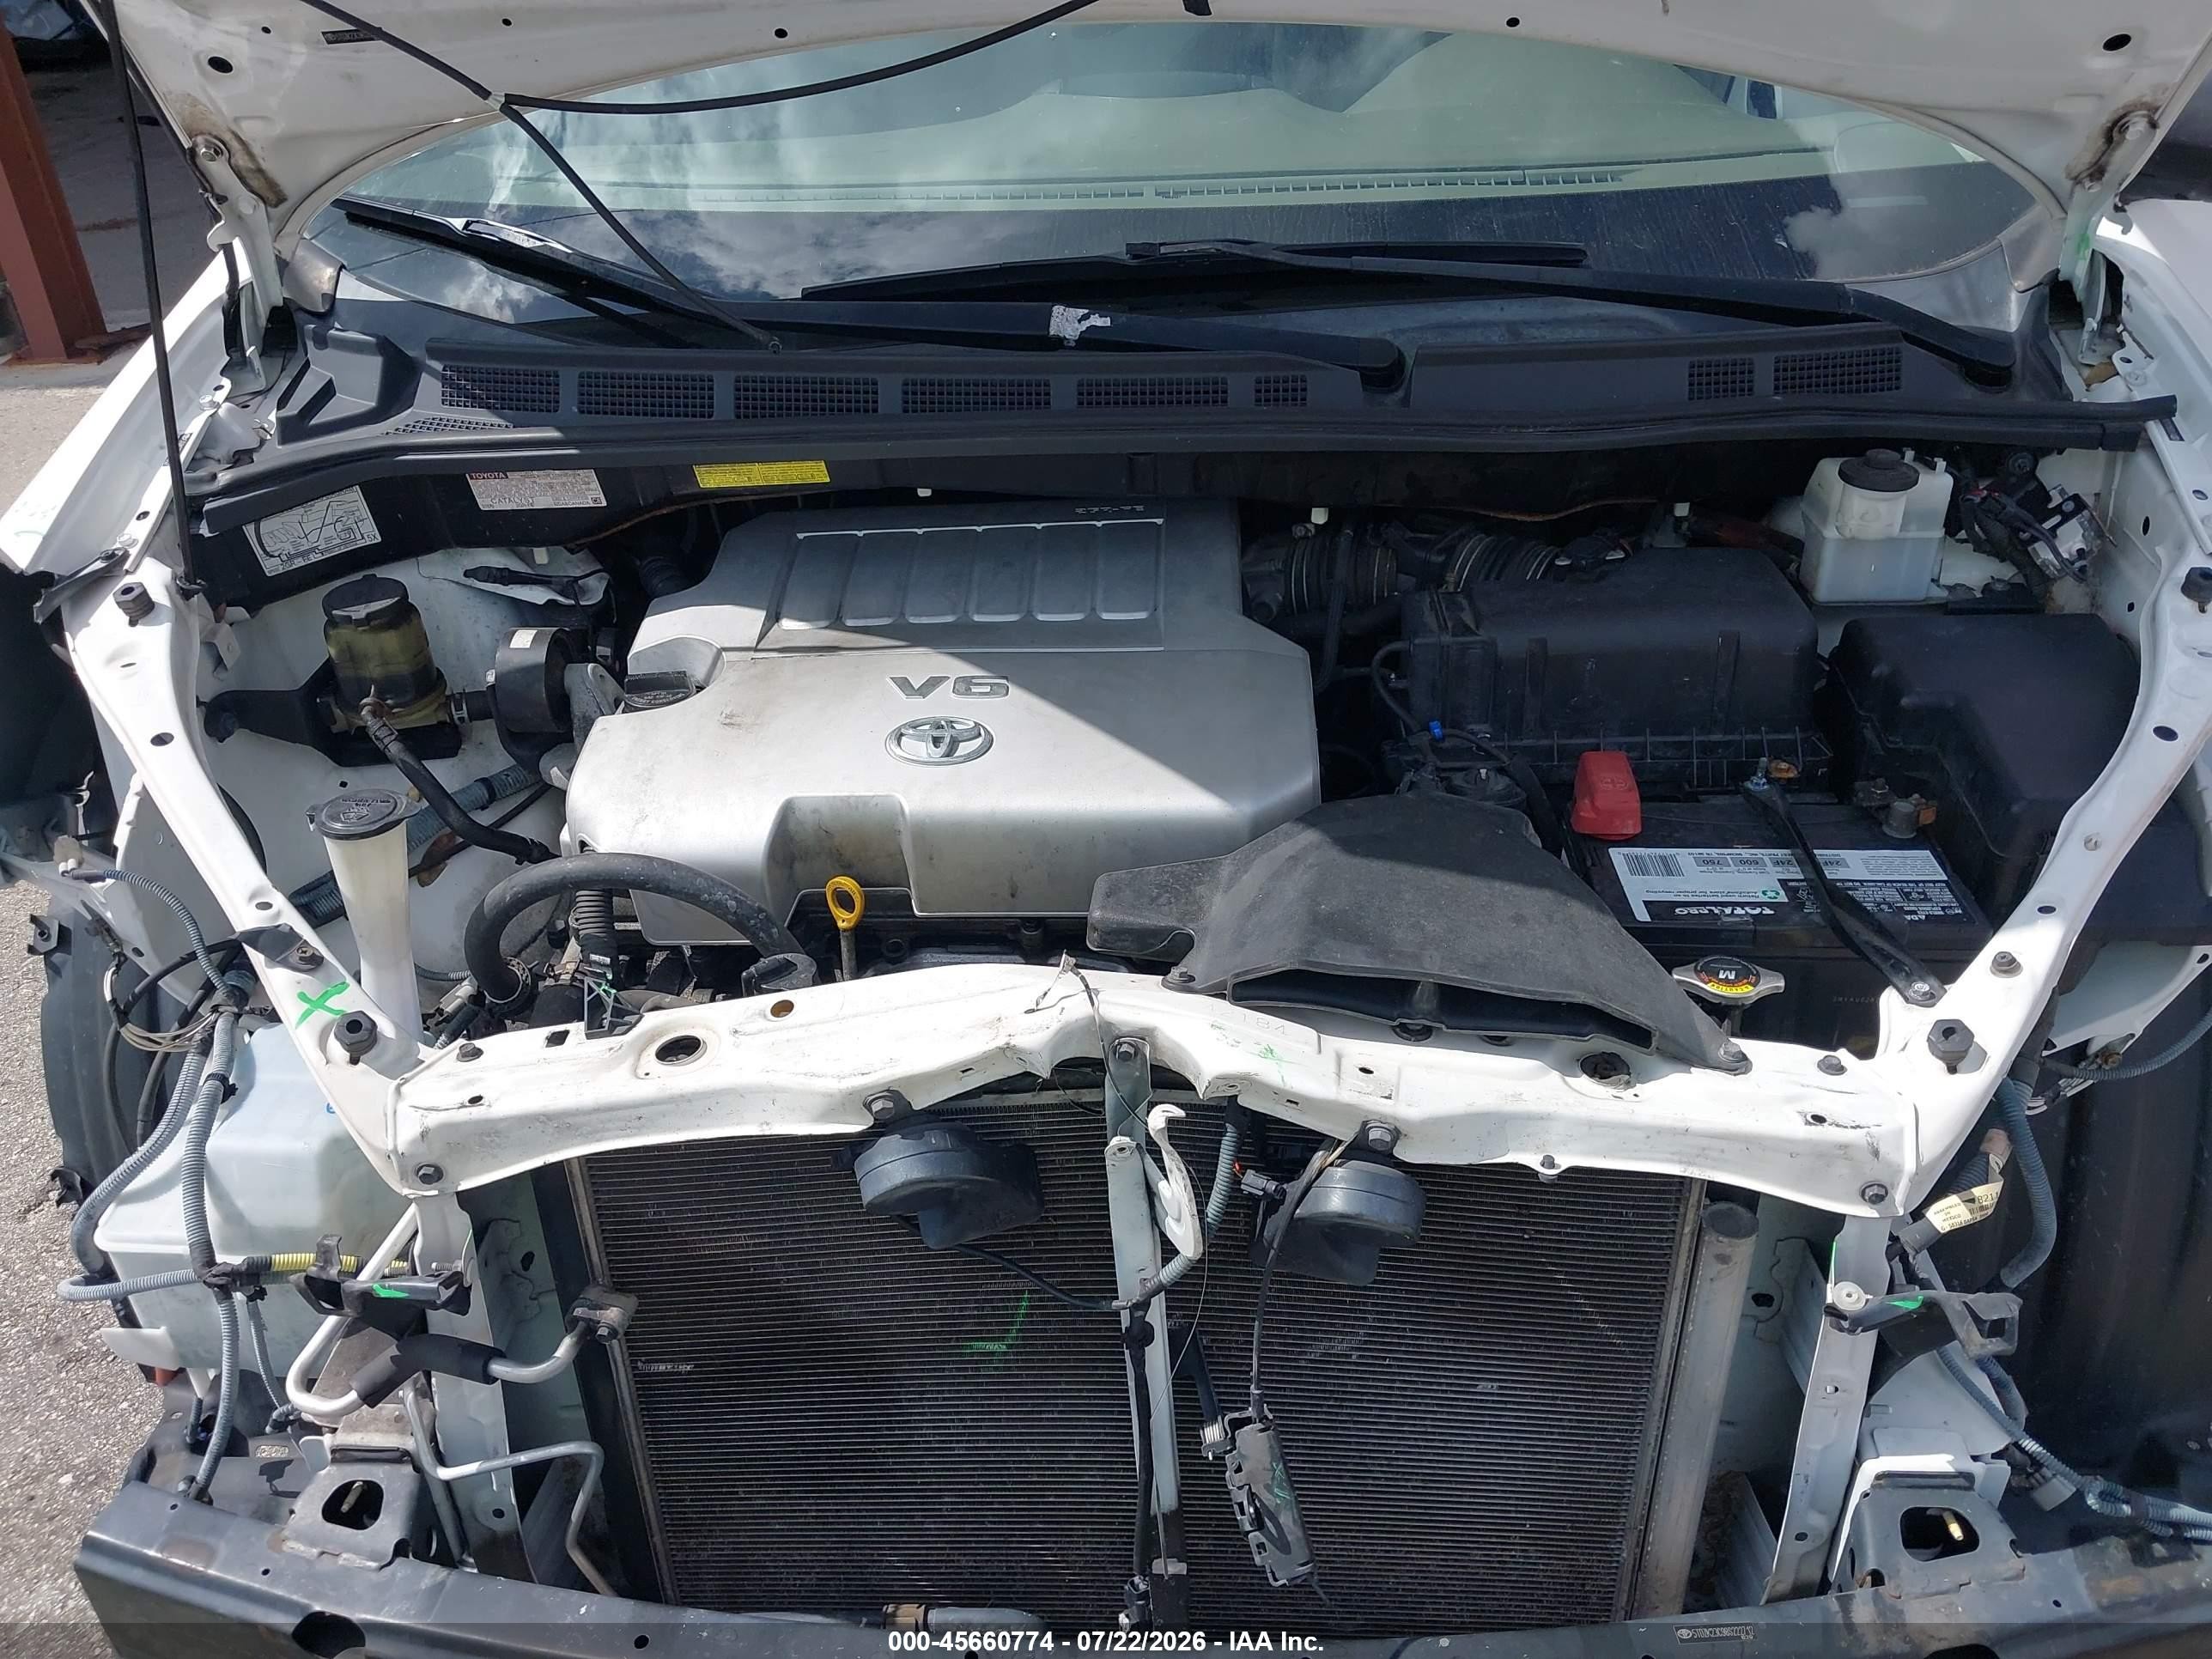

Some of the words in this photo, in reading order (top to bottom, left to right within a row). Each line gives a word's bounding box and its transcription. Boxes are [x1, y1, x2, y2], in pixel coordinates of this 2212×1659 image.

[368, 533, 380, 542] 5X
[888, 675, 1011, 700] V6
[1718, 969, 1736, 980] M
[1942, 1213, 1961, 1222] MEXICO
